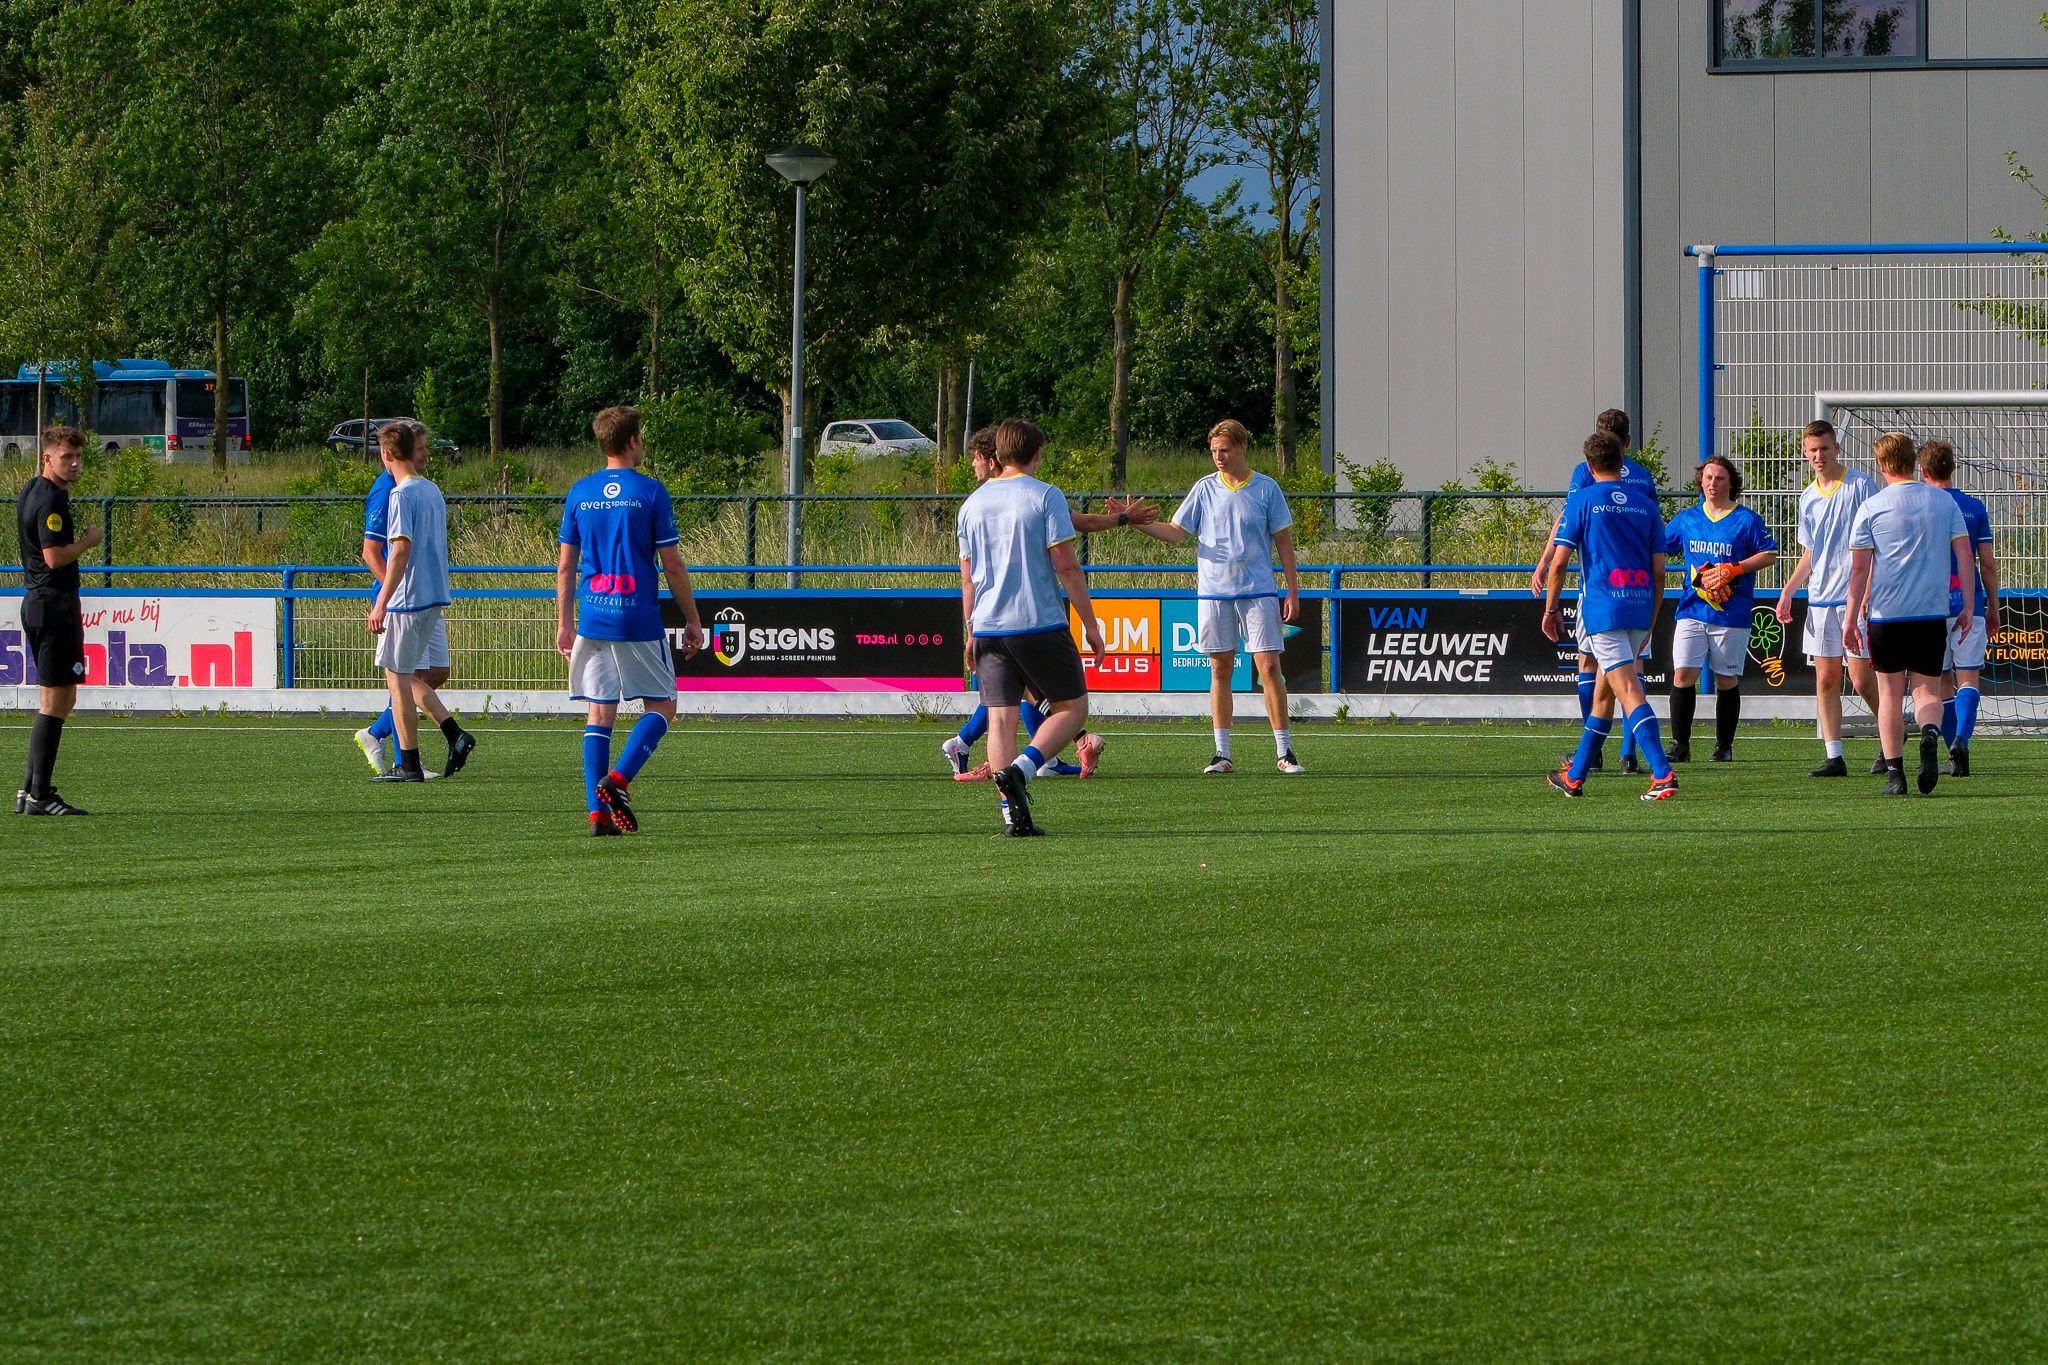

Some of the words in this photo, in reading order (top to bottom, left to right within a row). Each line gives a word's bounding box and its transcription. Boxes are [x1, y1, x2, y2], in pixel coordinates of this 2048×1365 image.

[1689, 540, 1733, 558] CURAÇAO
[112, 609, 135, 624] nu
[141, 598, 161, 632] bij
[1368, 607, 1428, 629] VAN
[748, 627, 835, 650] SIGNS
[855, 633, 899, 645] TDJS.nl
[1367, 633, 1509, 656] LEEUWEN
[1986, 631, 2045, 643] NSPIRED
[1985, 648, 1992, 660] Y
[1996, 648, 2048, 660] FLOWER
[1081, 658, 1149, 673] PLUS
[1367, 659, 1493, 682] FINANCE
